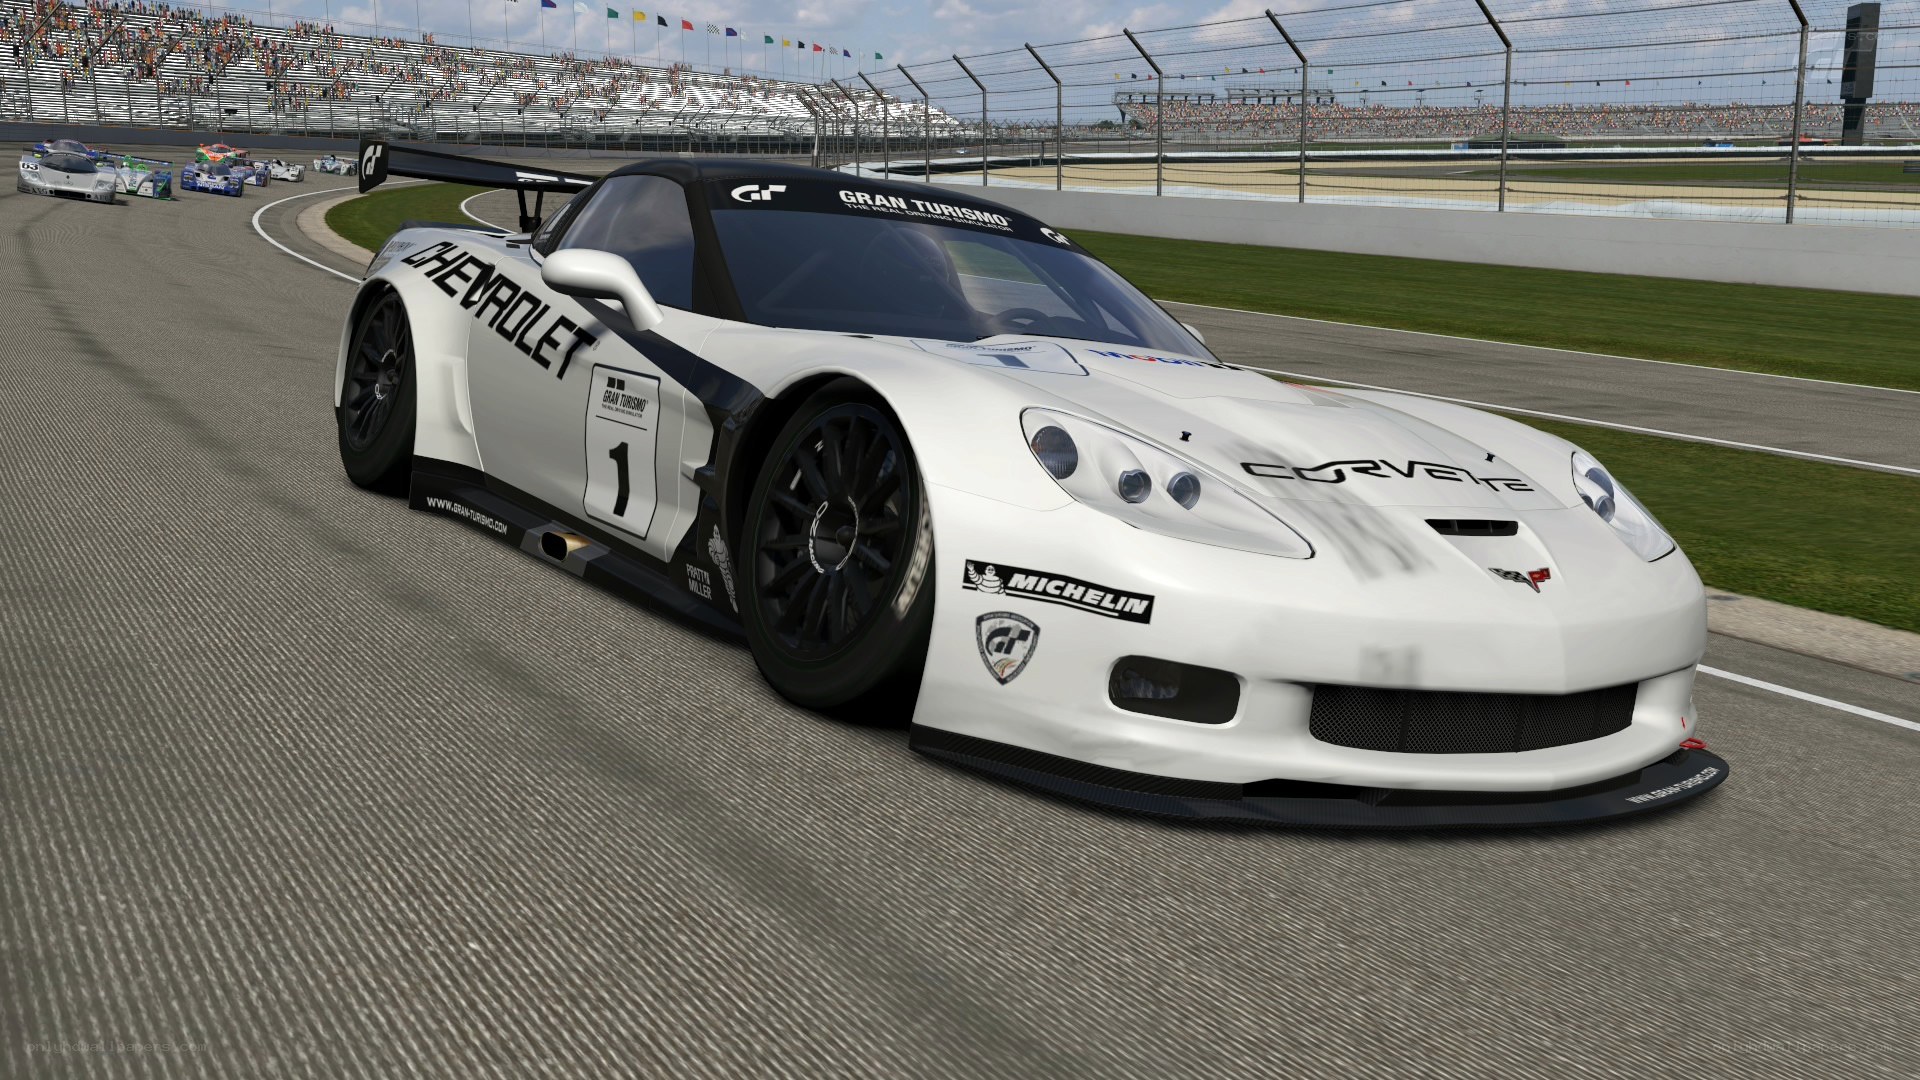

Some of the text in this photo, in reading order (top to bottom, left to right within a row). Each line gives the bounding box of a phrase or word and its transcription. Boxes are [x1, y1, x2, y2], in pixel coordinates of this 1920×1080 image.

[839, 190, 907, 210] GRAN
[845, 203, 1014, 232] THE REAL DRIVING SIMULATOR
[400, 241, 598, 380] CHEVROLET
[602, 389, 647, 412] GRAN TURISMO
[609, 441, 630, 517] 1
[1240, 459, 1535, 492] CORVETTE
[426, 496, 508, 535] WWW.GRAN-TURISMO.COM
[688, 578, 713, 601] MILLER
[1008, 573, 1150, 615] MICHELIN
